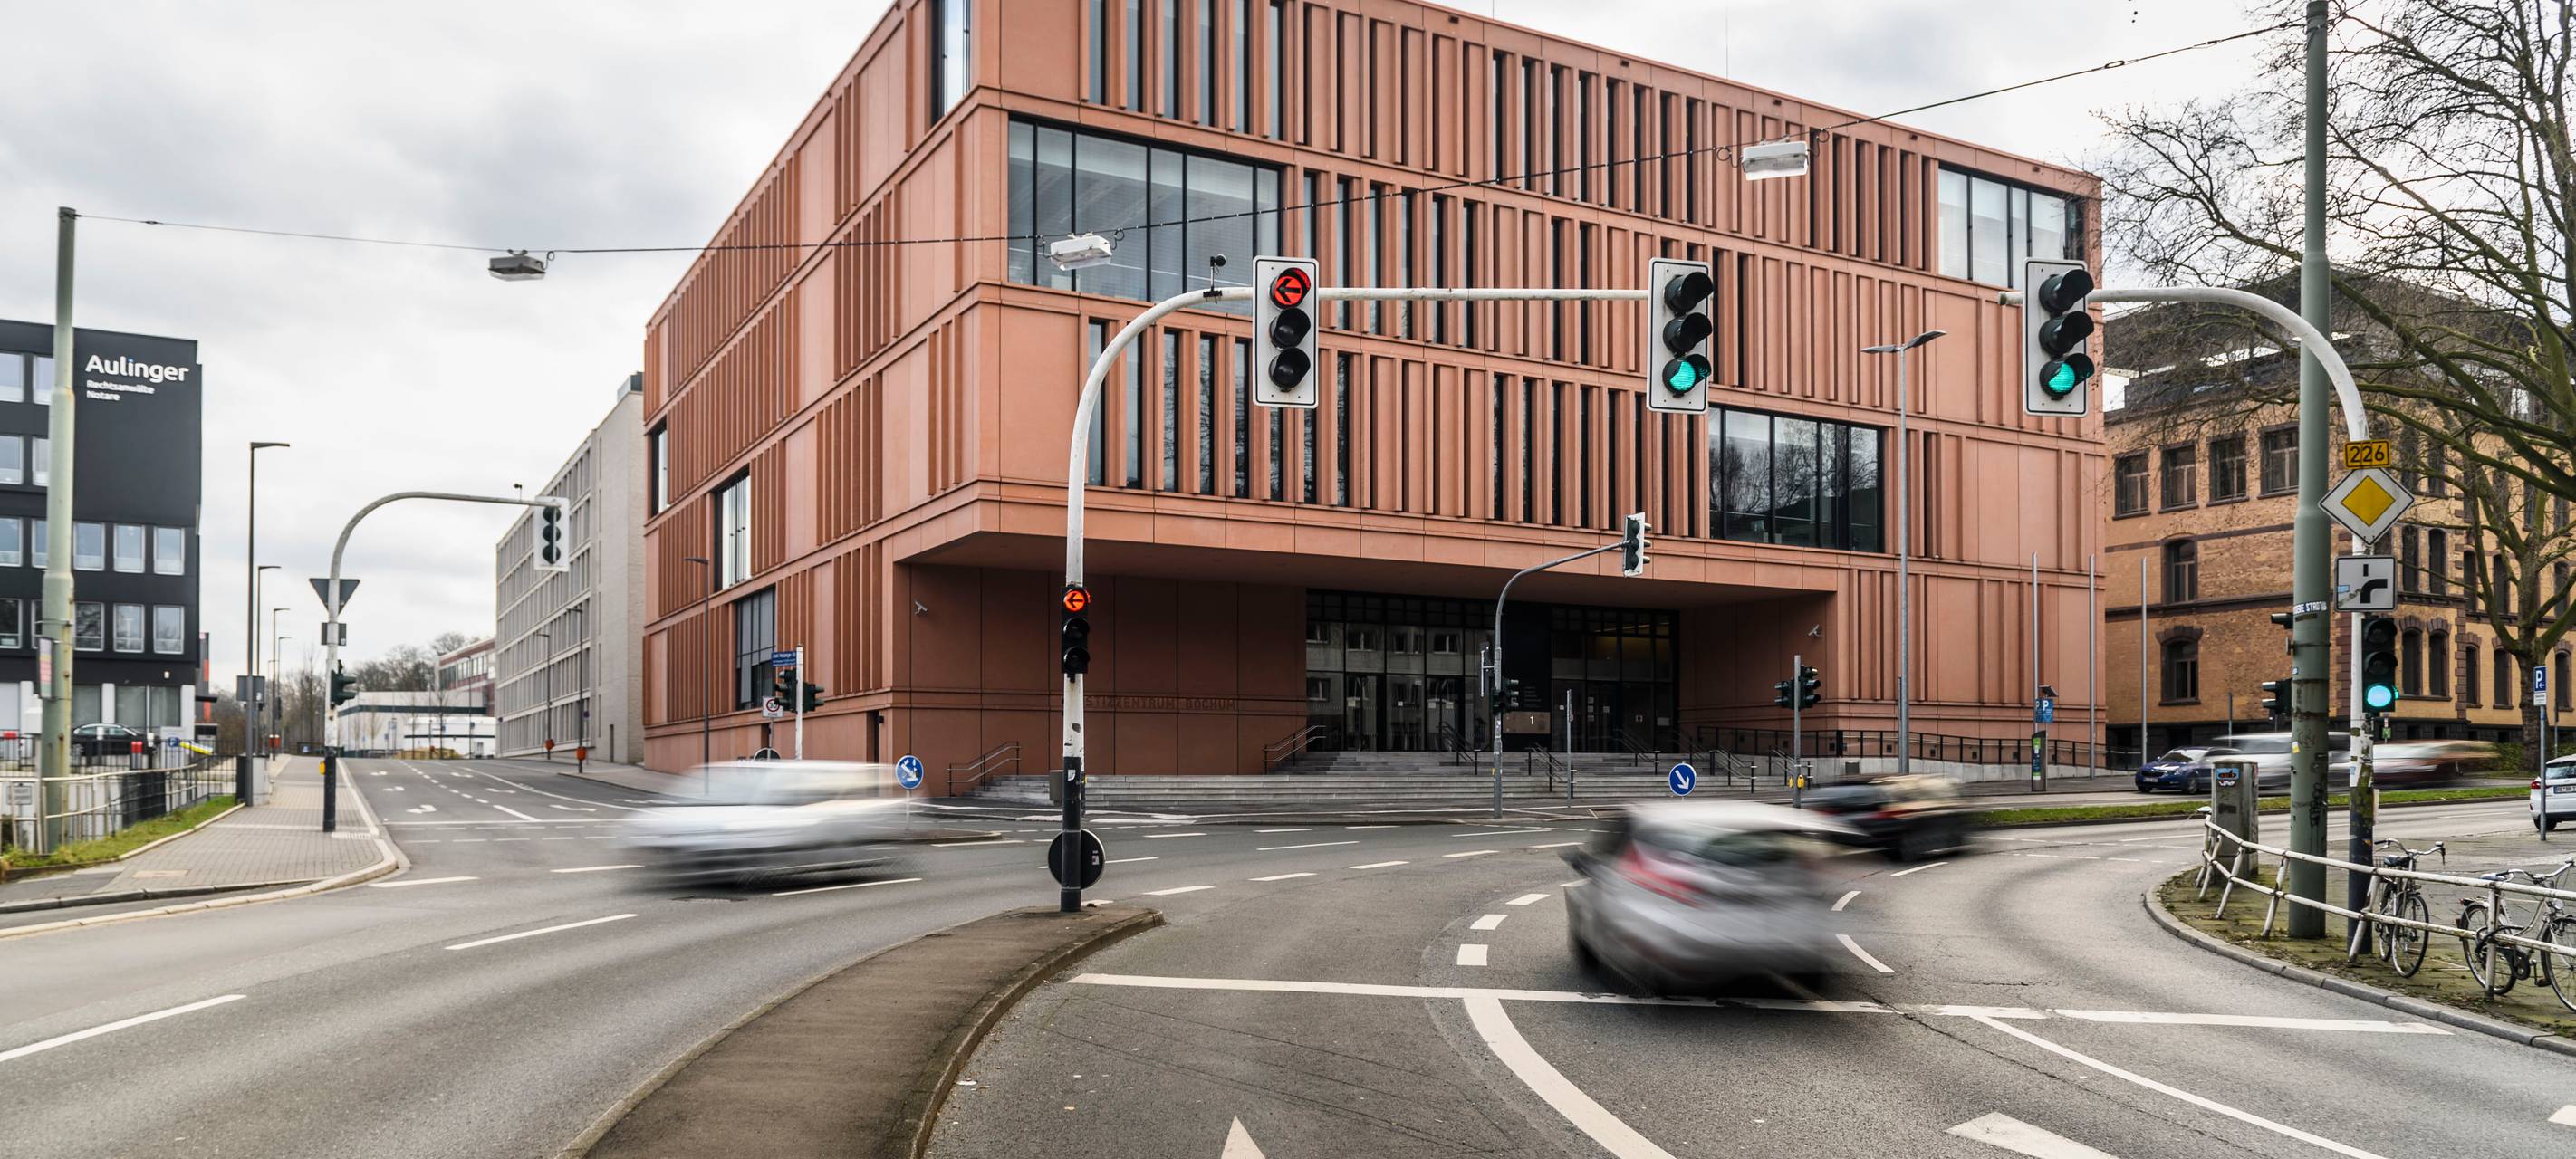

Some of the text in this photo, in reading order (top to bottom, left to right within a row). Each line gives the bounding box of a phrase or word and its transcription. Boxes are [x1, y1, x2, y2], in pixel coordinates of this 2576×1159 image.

[85, 354, 189, 383] Aulinger
[86, 390, 120, 401] Notare
[2350, 445, 2385, 463] 226
[2535, 670, 2543, 689] P
[1086, 695, 1236, 711] STIZZENTRUM BOCHUM
[2043, 700, 2050, 712] P
[1530, 715, 1534, 725] 1
